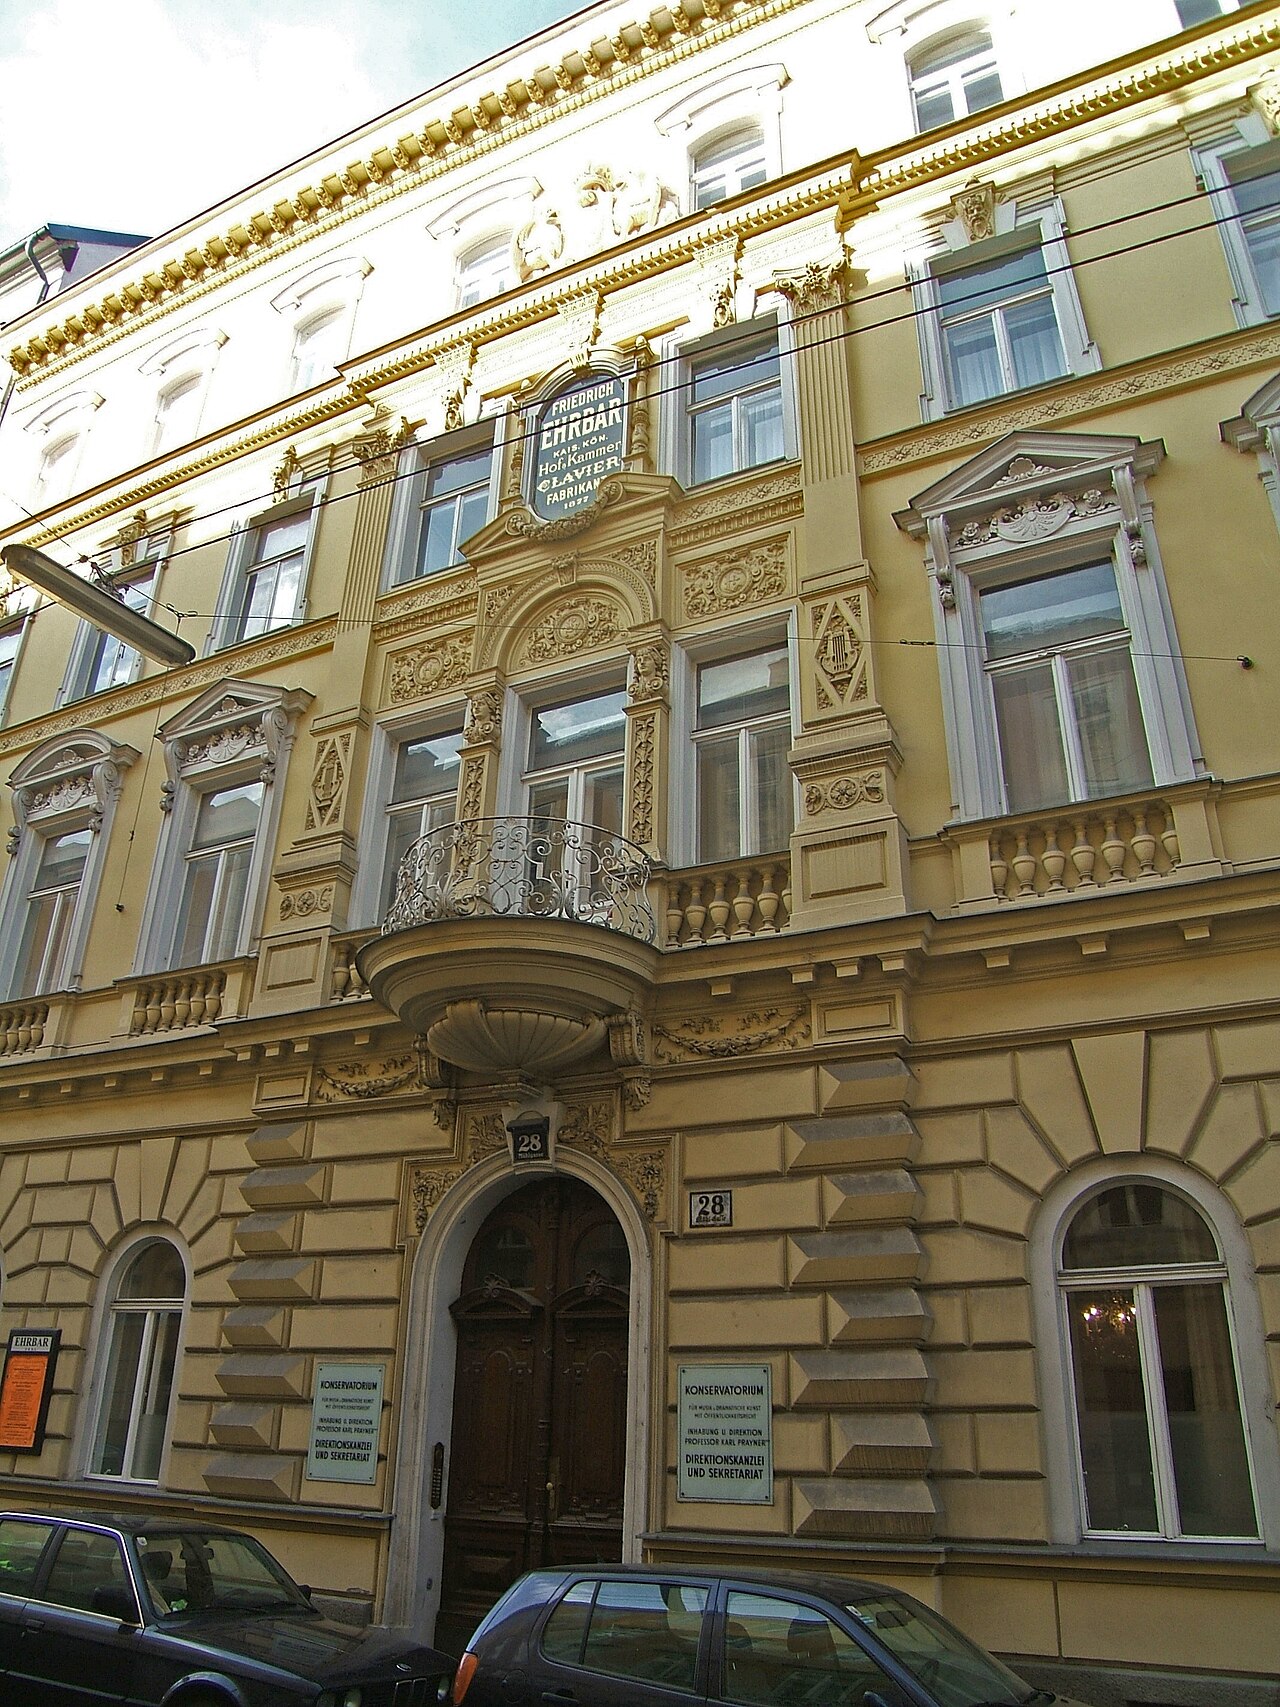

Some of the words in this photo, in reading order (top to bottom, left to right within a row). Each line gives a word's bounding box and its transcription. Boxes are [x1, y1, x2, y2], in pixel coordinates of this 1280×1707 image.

[552, 381, 614, 416] FRIEDRICH
[541, 397, 622, 450] EHRBAR
[518, 1134, 542, 1152] 28
[698, 1194, 724, 1216] 28
[15, 1337, 49, 1347] EHRBAR
[320, 1380, 378, 1390] KONSERVATORIUM
[685, 1385, 764, 1396] KONSERVATORIUM
[687, 1428, 719, 1436] INHABUNG
[315, 1439, 373, 1451] DIREKTIONSKANZLEI
[685, 1437, 719, 1446] PROFESSOR
[315, 1450, 329, 1460] UND
[330, 1451, 371, 1462] SEKRETARIAT
[685, 1454, 765, 1466] DIREKTIONSKANZLEI
[687, 1467, 706, 1478] UND
[708, 1468, 764, 1480] SEKRETARIAT
